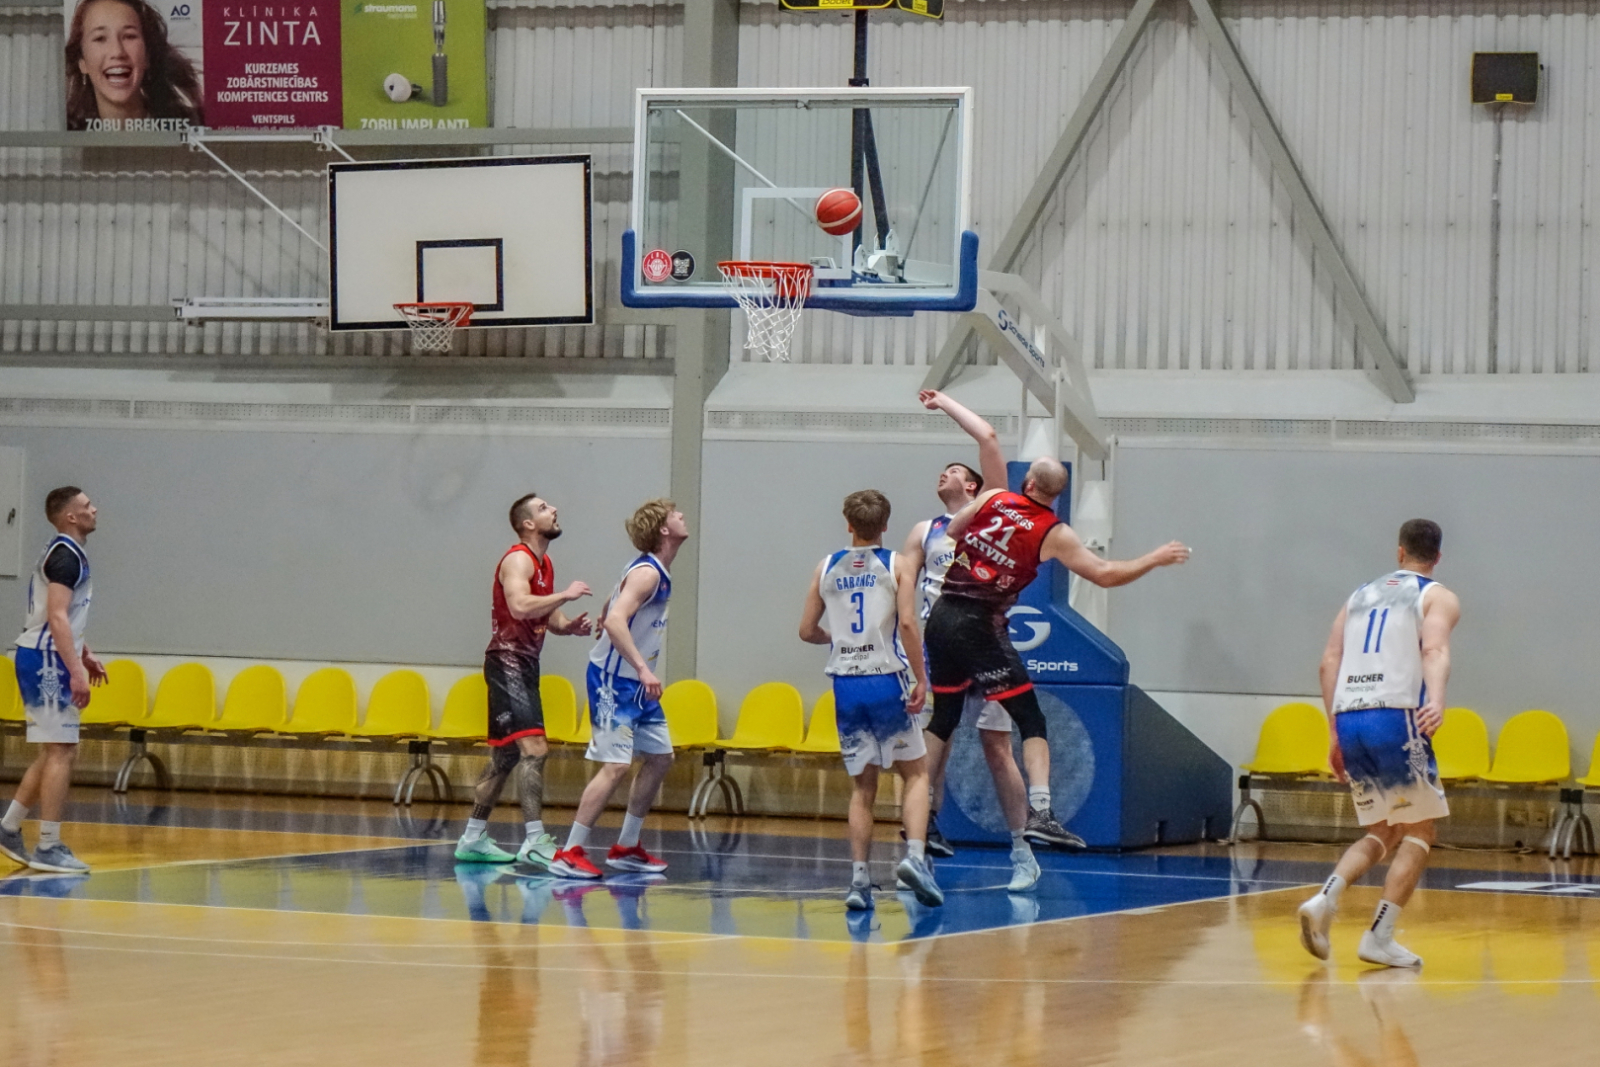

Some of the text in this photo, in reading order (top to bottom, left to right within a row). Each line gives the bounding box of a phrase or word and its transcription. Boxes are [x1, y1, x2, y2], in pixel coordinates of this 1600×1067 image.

[223, 6, 318, 17] KLĪNIKA
[364, 4, 417, 13] straumann
[223, 21, 321, 46] ZINTA
[245, 63, 299, 74] KURZEMES
[227, 75, 318, 88] ZOBĀRSTNIECĪBAS
[217, 91, 328, 102] KOMPETENCES CENTRS
[85, 118, 190, 132] ZOBU BREKETES
[252, 115, 295, 124] VENTSPILS
[979, 516, 1016, 552] 21
[851, 592, 864, 634] 3
[1363, 608, 1389, 653] 11
[1026, 659, 1079, 673] Sports
[1347, 673, 1384, 684] BUCHER
